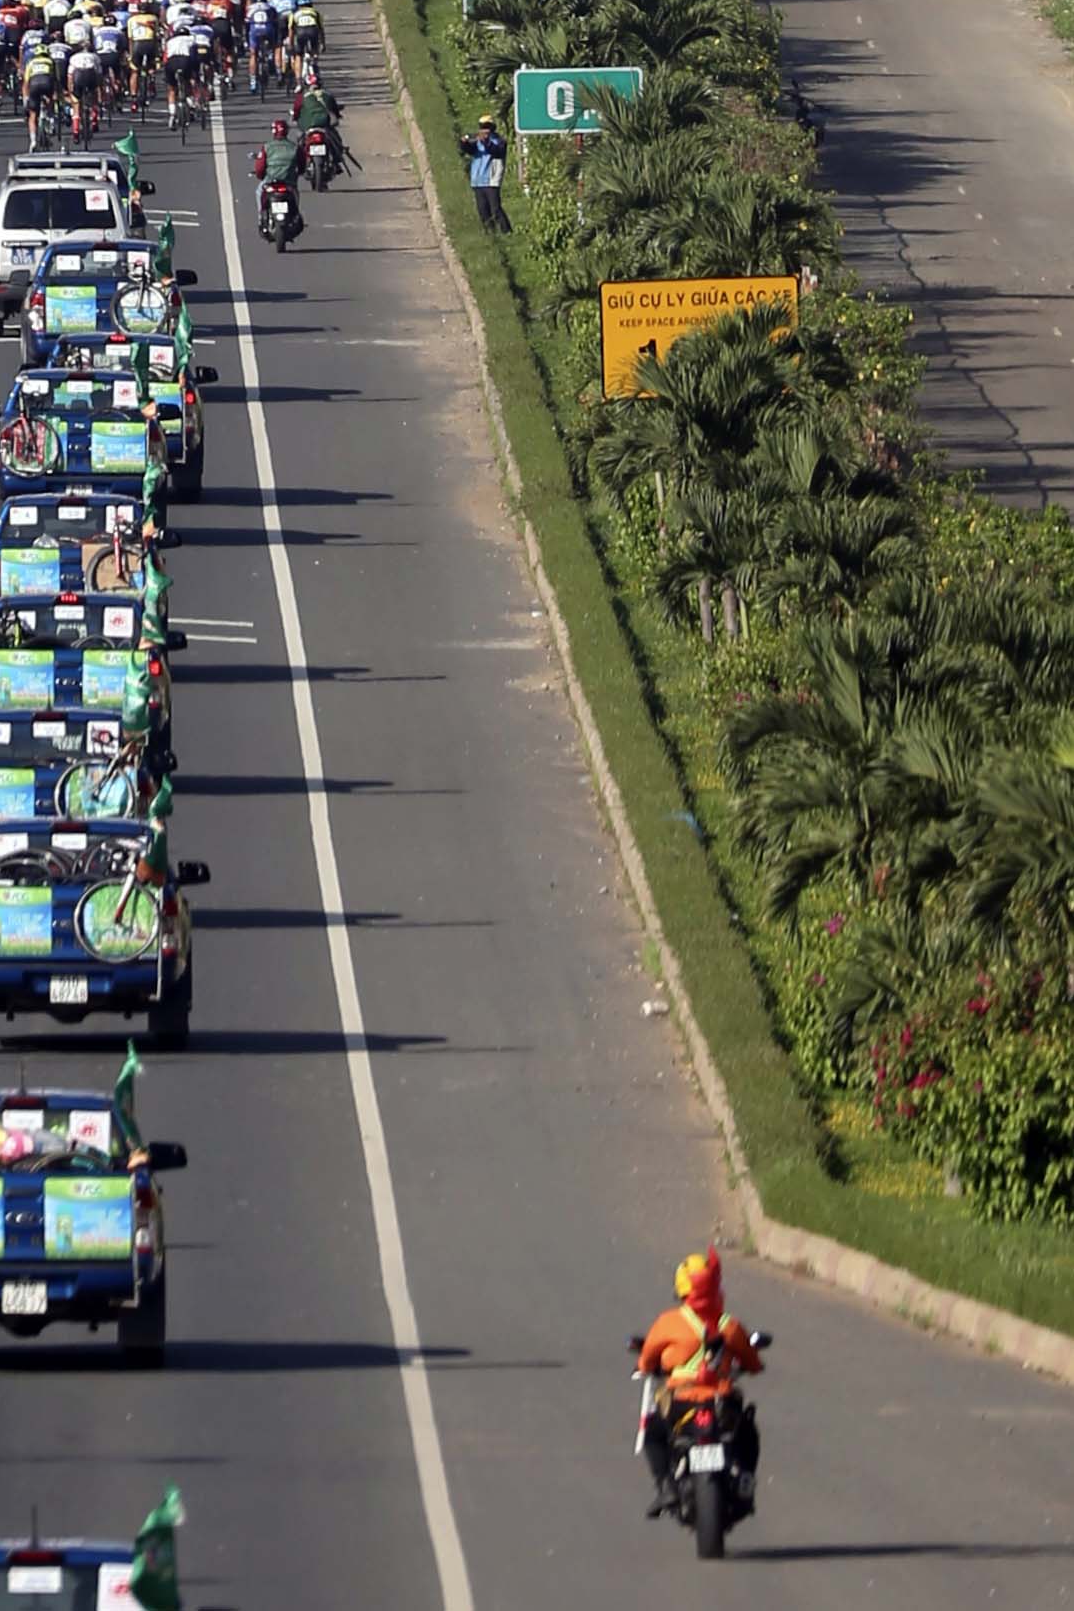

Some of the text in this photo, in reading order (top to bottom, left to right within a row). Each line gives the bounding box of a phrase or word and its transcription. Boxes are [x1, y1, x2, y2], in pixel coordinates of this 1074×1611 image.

[639, 291, 663, 310] CỰ
[666, 292, 686, 307] LY
[690, 286, 730, 306] GIỮA
[733, 286, 767, 306] CÁC
[619, 317, 643, 328] KEEP
[645, 316, 675, 327] SPACE
